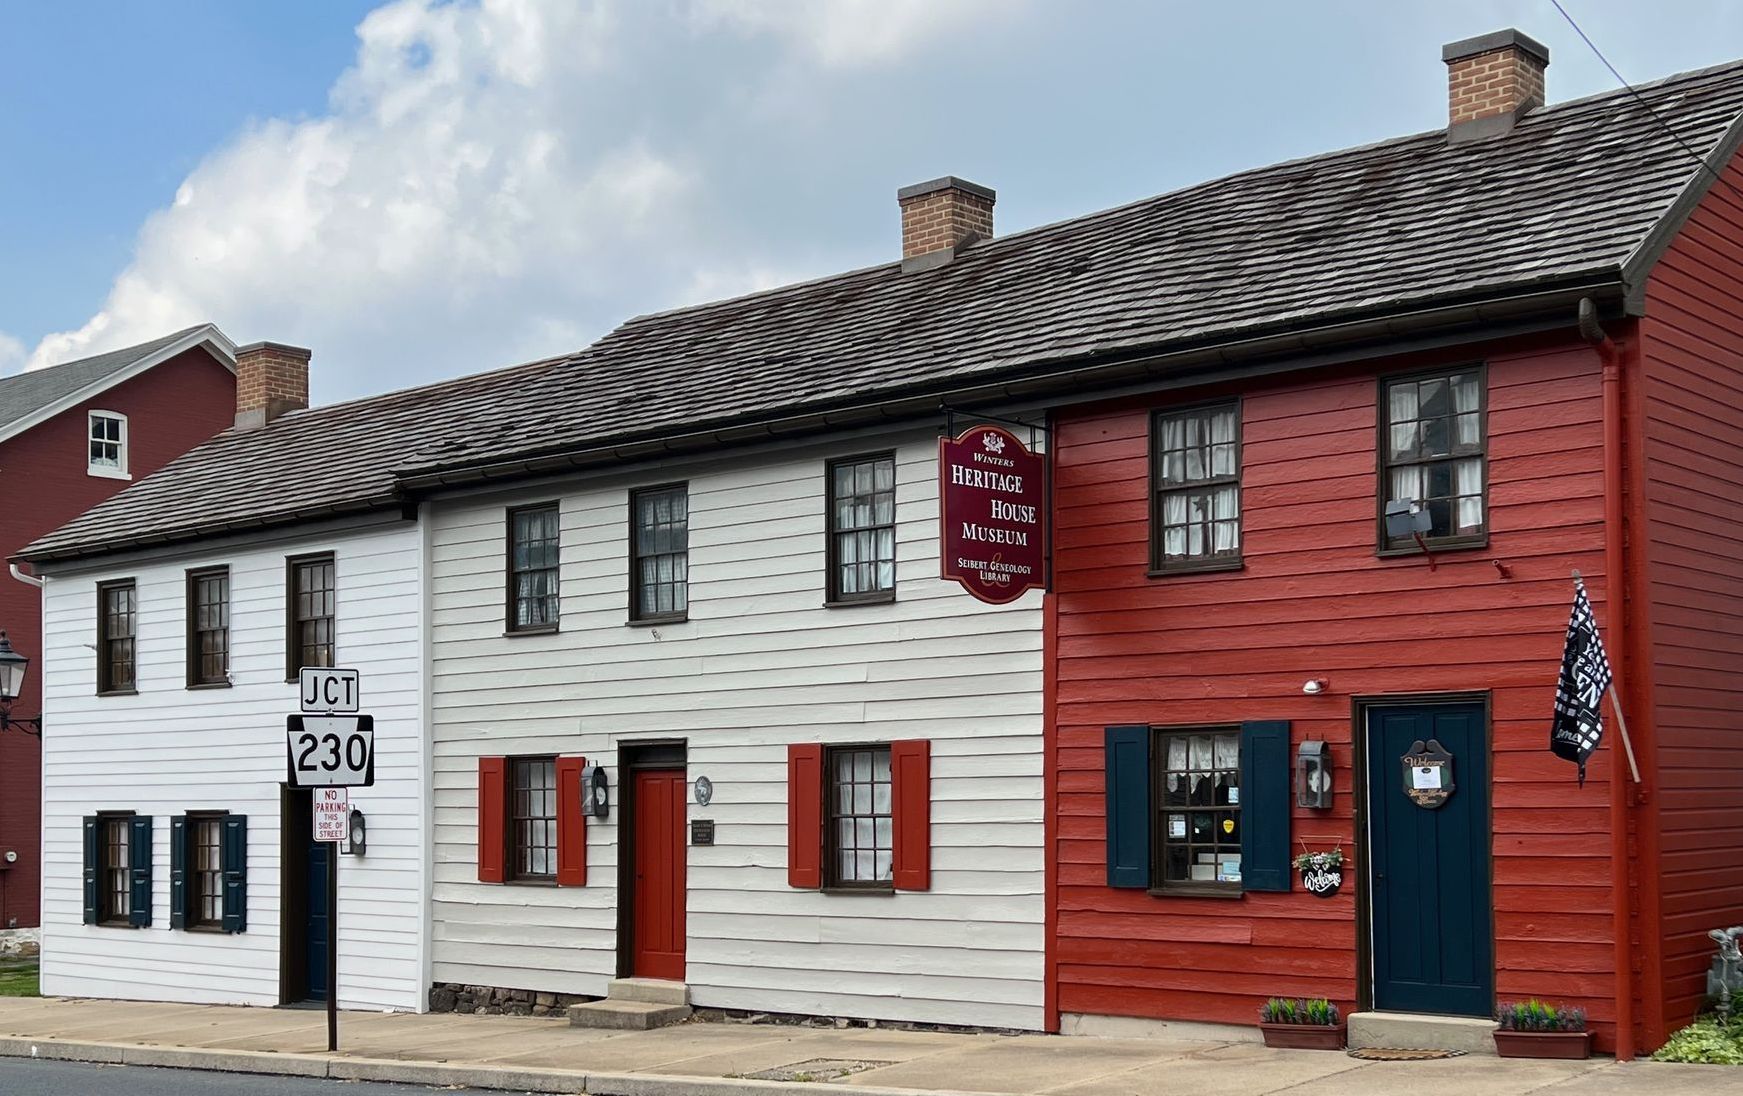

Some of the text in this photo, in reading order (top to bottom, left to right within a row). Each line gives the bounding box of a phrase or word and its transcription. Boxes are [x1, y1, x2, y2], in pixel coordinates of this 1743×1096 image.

[973, 452, 1014, 467] WINTERS
[951, 464, 1023, 493] HERITAGE
[991, 499, 1036, 524] HOUSE
[961, 522, 1027, 546] MUSEUM
[957, 557, 1032, 575] SEIBERT GENEOLOGY
[979, 570, 1011, 582] LIBRARY
[304, 676, 355, 705] JCT
[297, 733, 367, 771] 230
[324, 790, 338, 800] NO
[316, 802, 346, 813] PARKING
[324, 813, 338, 821] THIS
[318, 821, 343, 830] SIDE OF
[319, 830, 343, 838] STREET
